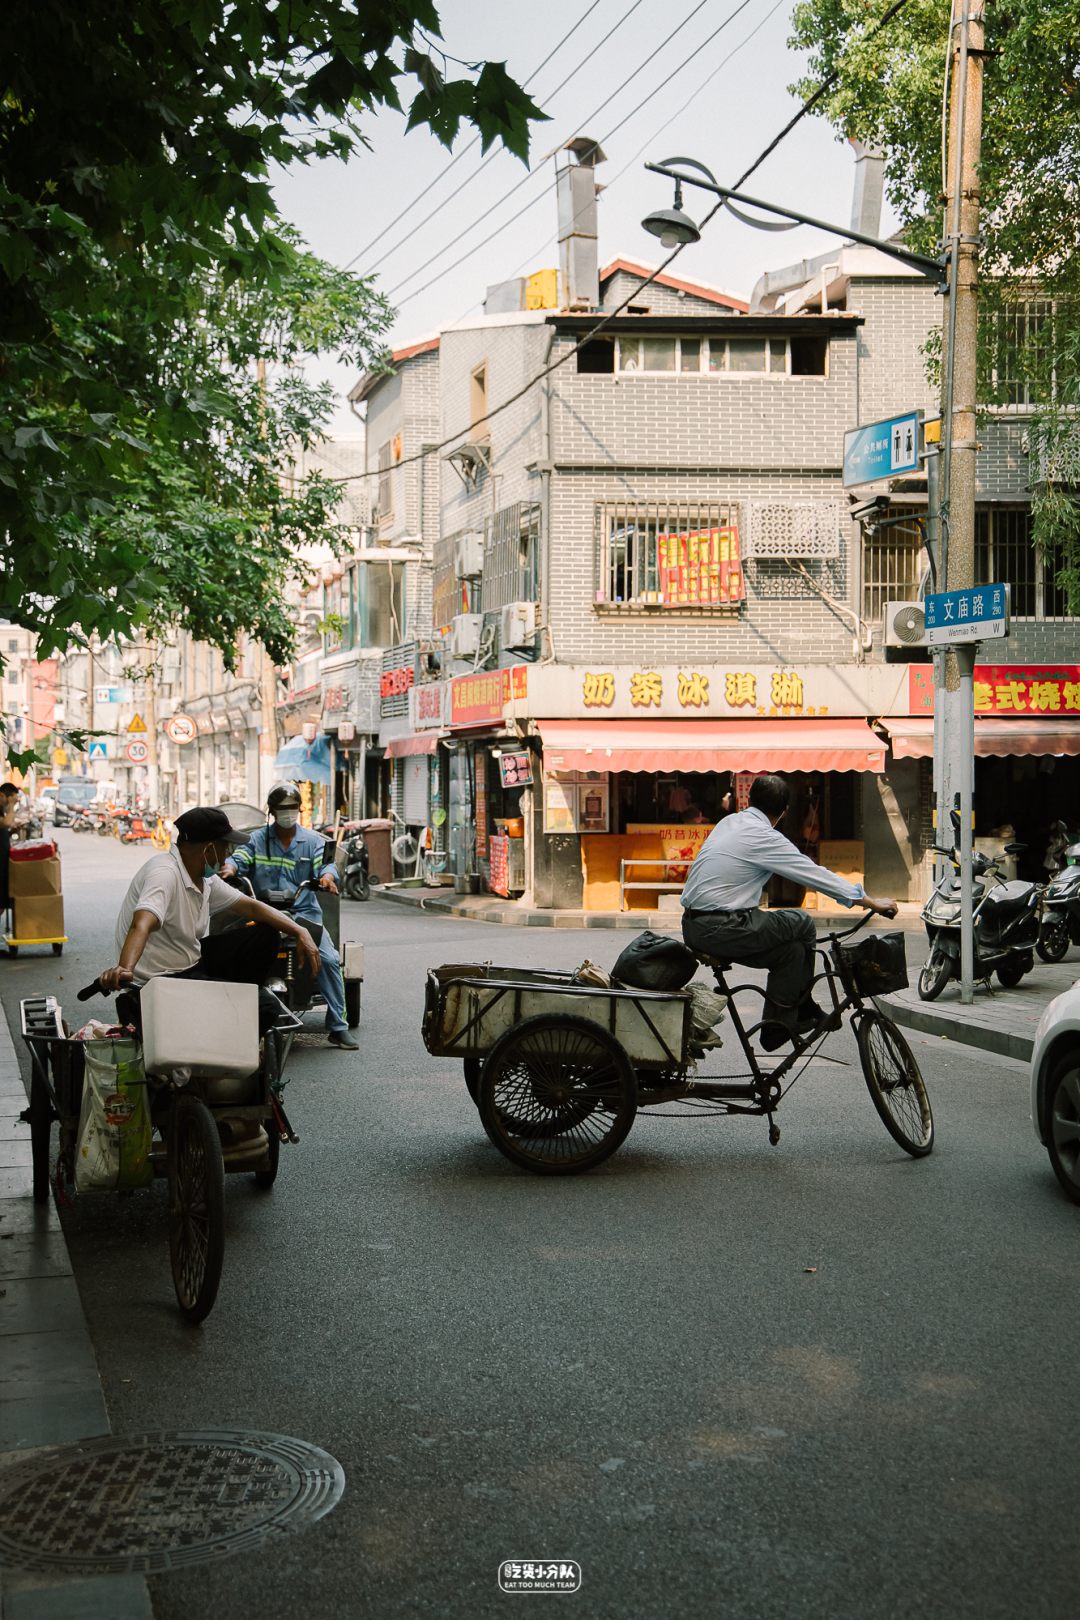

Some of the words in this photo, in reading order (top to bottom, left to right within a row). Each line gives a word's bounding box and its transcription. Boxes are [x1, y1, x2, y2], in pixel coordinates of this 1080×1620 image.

[863, 438, 889, 455] 公共厕所
[867, 454, 883, 464] Toilet
[928, 600, 935, 614] 东
[943, 594, 984, 621] 文庙路
[993, 589, 1001, 604] 西
[927, 615, 936, 625] 200
[992, 606, 1001, 615] 290
[929, 631, 934, 641] E
[948, 628, 969, 637] Wenmiao
[970, 626, 978, 634] Rd.
[993, 623, 1000, 633] W
[583, 672, 804, 706] 奶茶冰淇淋
[132, 746, 145, 757] 30
